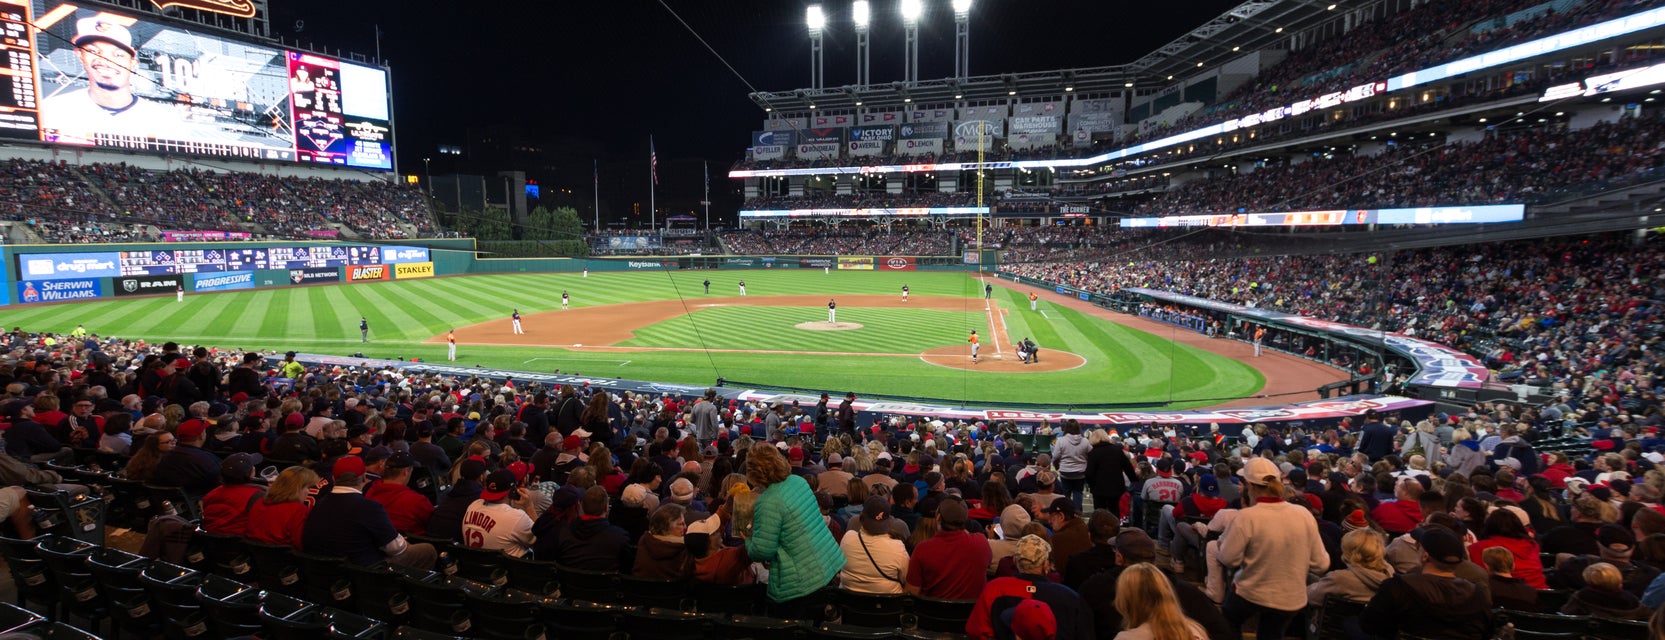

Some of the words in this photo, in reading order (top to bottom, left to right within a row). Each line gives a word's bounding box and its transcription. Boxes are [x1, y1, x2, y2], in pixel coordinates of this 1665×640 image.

[1013, 122, 1056, 130] WAREHOUSE
[914, 140, 933, 148] LEMON
[56, 262, 86, 273] drug
[86, 261, 114, 270] mart
[628, 260, 661, 269] KeyBank
[352, 267, 383, 280] BLASTER
[397, 266, 431, 275] STANLEY
[42, 281, 93, 291] SHERWIN
[140, 280, 177, 288] RAM
[196, 274, 253, 289] PROGRESSIVE
[41, 289, 97, 300] WILLIAMS.
[1159, 488, 1177, 502] 21
[464, 510, 497, 534] LINDOR
[465, 528, 484, 548] 12
